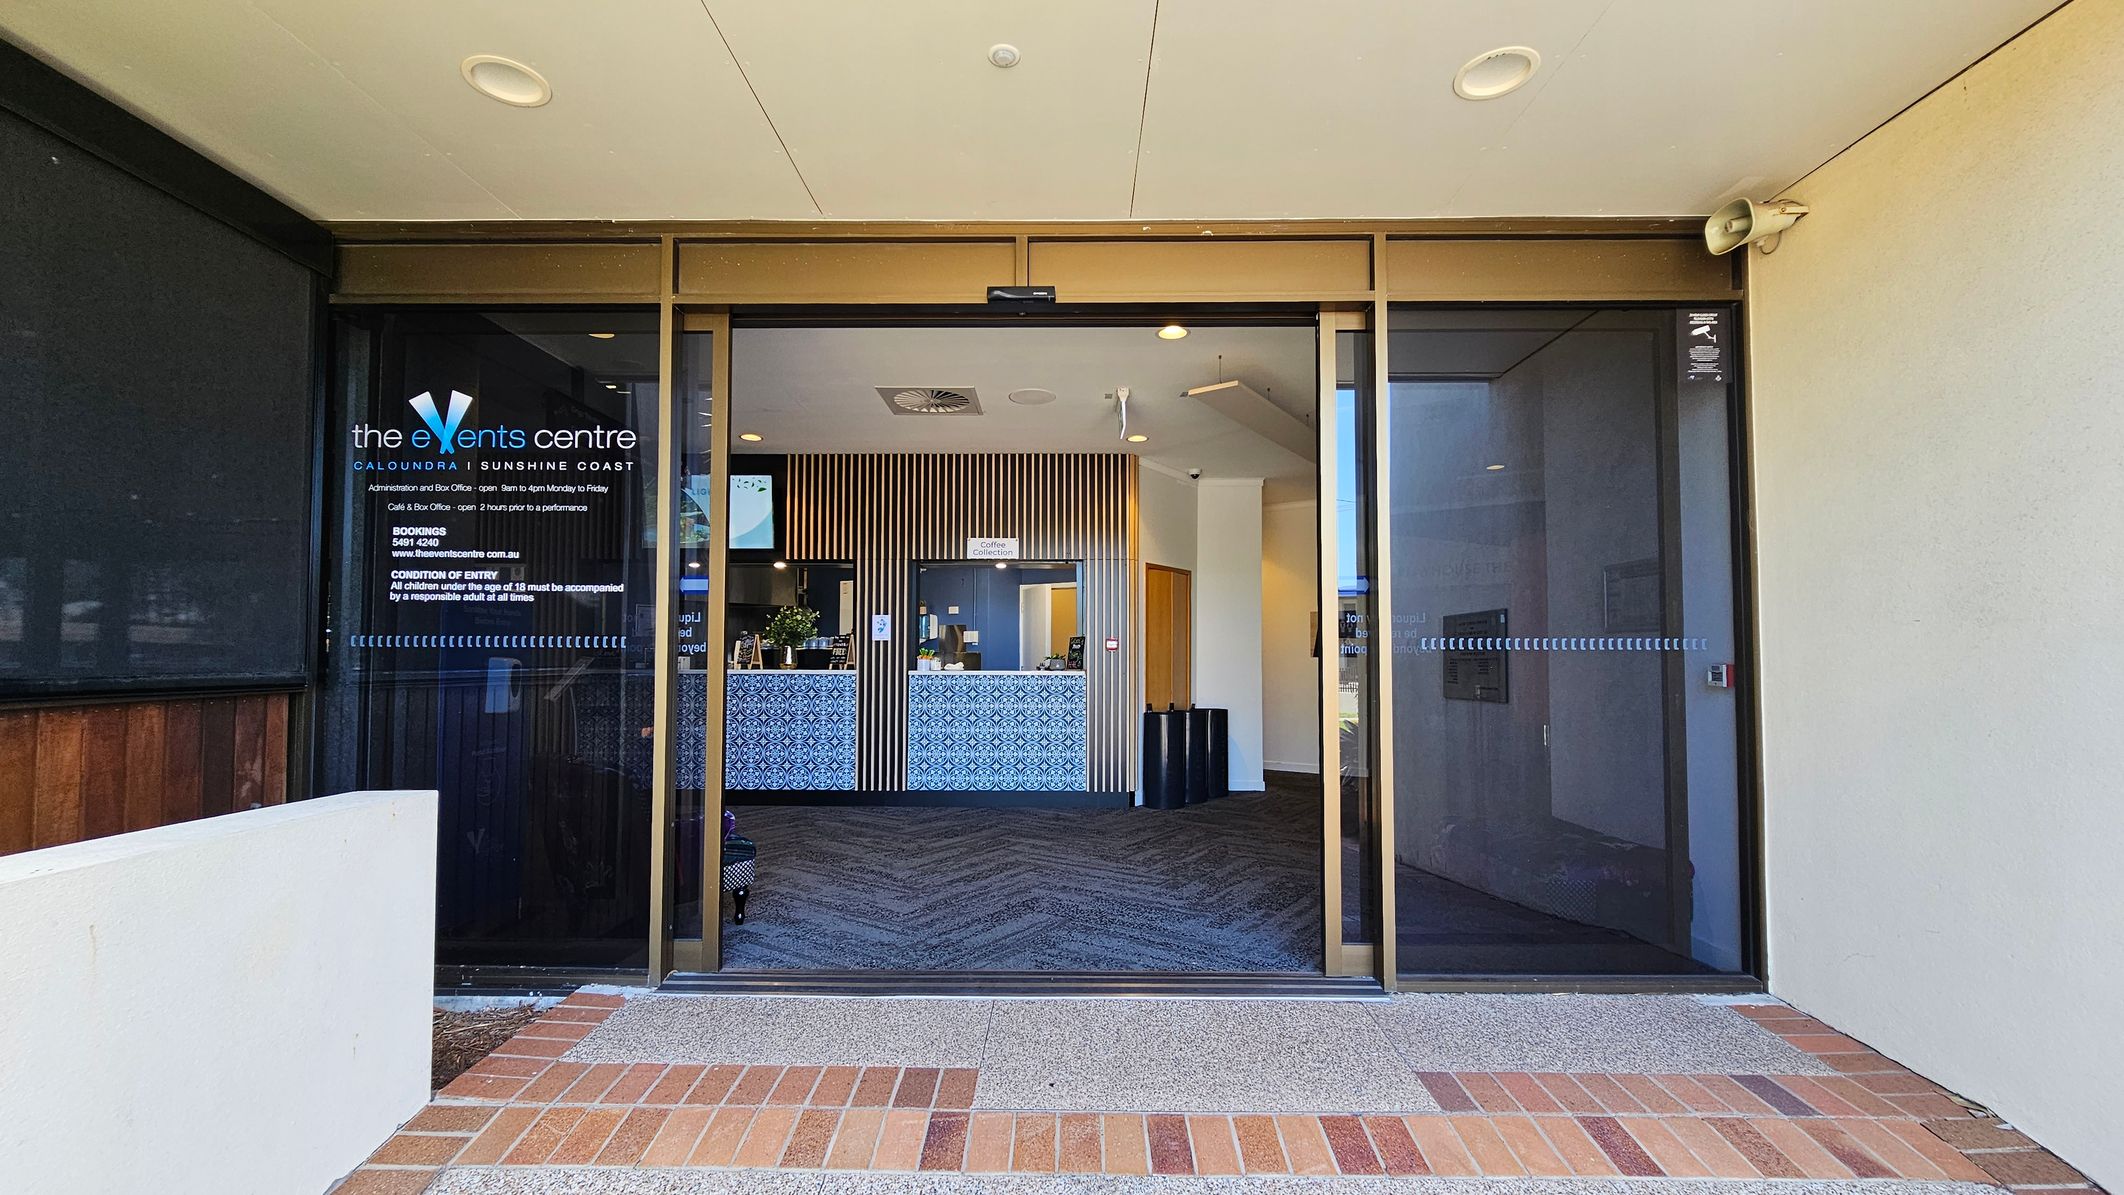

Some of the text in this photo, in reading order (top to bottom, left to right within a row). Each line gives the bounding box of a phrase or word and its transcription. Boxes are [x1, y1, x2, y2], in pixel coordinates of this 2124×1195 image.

[351, 423, 403, 449] the
[534, 424, 637, 449] centre
[353, 461, 458, 471] CALOUNDRA
[480, 461, 568, 471] SUNSHINE
[577, 461, 634, 471] COAST
[368, 483, 419, 492] Administration
[419, 484, 434, 492] and
[435, 484, 450, 492] Box
[450, 483, 472, 492] Office
[478, 485, 498, 493] open
[501, 484, 518, 492] 9am
[519, 484, 527, 492] to
[528, 484, 545, 493] 4pm
[546, 484, 576, 493] Monday
[577, 484, 586, 492] to
[586, 484, 609, 494] Friday
[387, 502, 405, 511] Café
[406, 503, 413, 511] &
[413, 502, 429, 511] Box
[429, 502, 451, 511] Office
[457, 504, 477, 513] open
[479, 503, 486, 511] 2
[486, 503, 508, 512] hours
[508, 503, 526, 513] prior
[526, 503, 535, 511] to
[542, 503, 588, 513] performance
[392, 526, 447, 536] BOOKINGS
[391, 538, 440, 547] 5491 4240
[980, 541, 1006, 549] Coffee
[972, 549, 1014, 557] Collection
[390, 570, 499, 580] CONDITION OF ENTRY
[390, 581, 625, 593] All children under the age of 18 must be accompanied
[389, 591, 535, 603] by a responsible adult at all times
